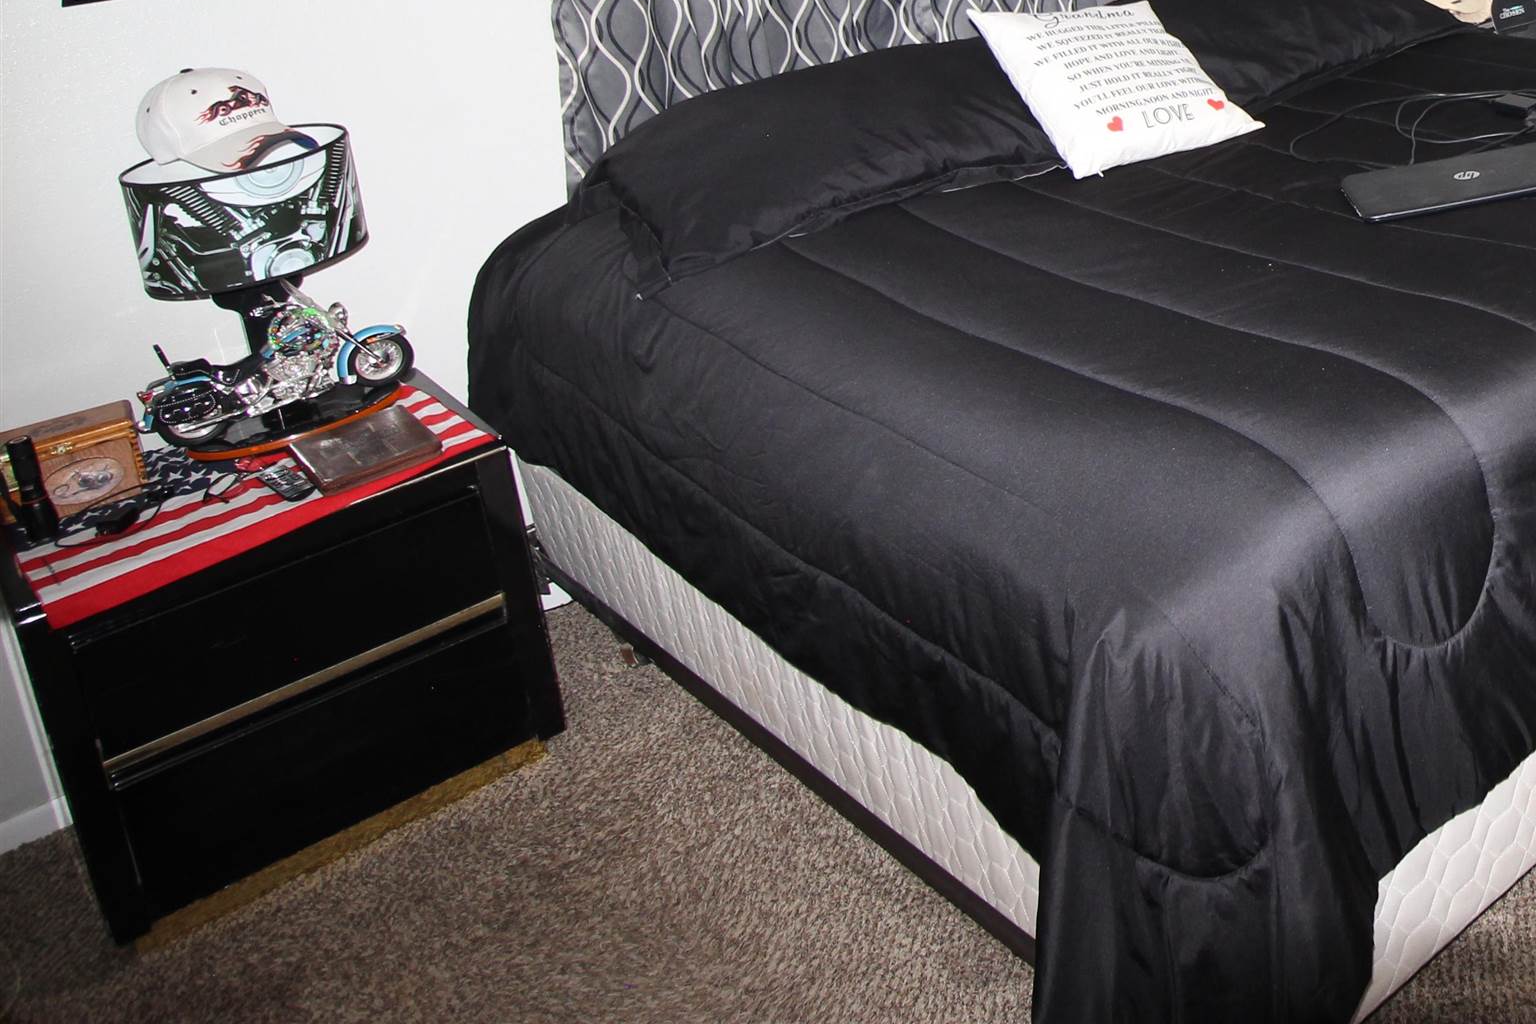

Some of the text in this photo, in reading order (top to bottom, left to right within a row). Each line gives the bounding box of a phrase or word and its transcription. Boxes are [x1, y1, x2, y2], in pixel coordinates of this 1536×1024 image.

[1026, 32, 1042, 41] WE
[1045, 24, 1084, 36] HUGGED
[1037, 42, 1053, 51] WE
[1055, 33, 1104, 45] SQUEEZED
[1114, 28, 1147, 36] REALLY
[1034, 57, 1049, 67] WE
[1052, 46, 1087, 60] FILLED
[1099, 40, 1125, 49] WITH
[1064, 57, 1090, 69] HOPE
[1094, 53, 1113, 61] AND
[1114, 49, 1136, 57] LOVE
[1067, 72, 1082, 81] SO
[1082, 65, 1113, 76] WHEN
[1080, 80, 1102, 92] JUST
[1104, 74, 1130, 85] HOLD
[1131, 72, 1141, 80] IT
[1142, 70, 1173, 78] REALLY
[1110, 87, 1133, 97] FEEL
[1135, 82, 1154, 92] OUR
[1155, 79, 1177, 89] LOVE
[1171, 90, 1188, 98] AND
[1188, 87, 1214, 97] NIGHT
[1141, 103, 1196, 128] LOVE
